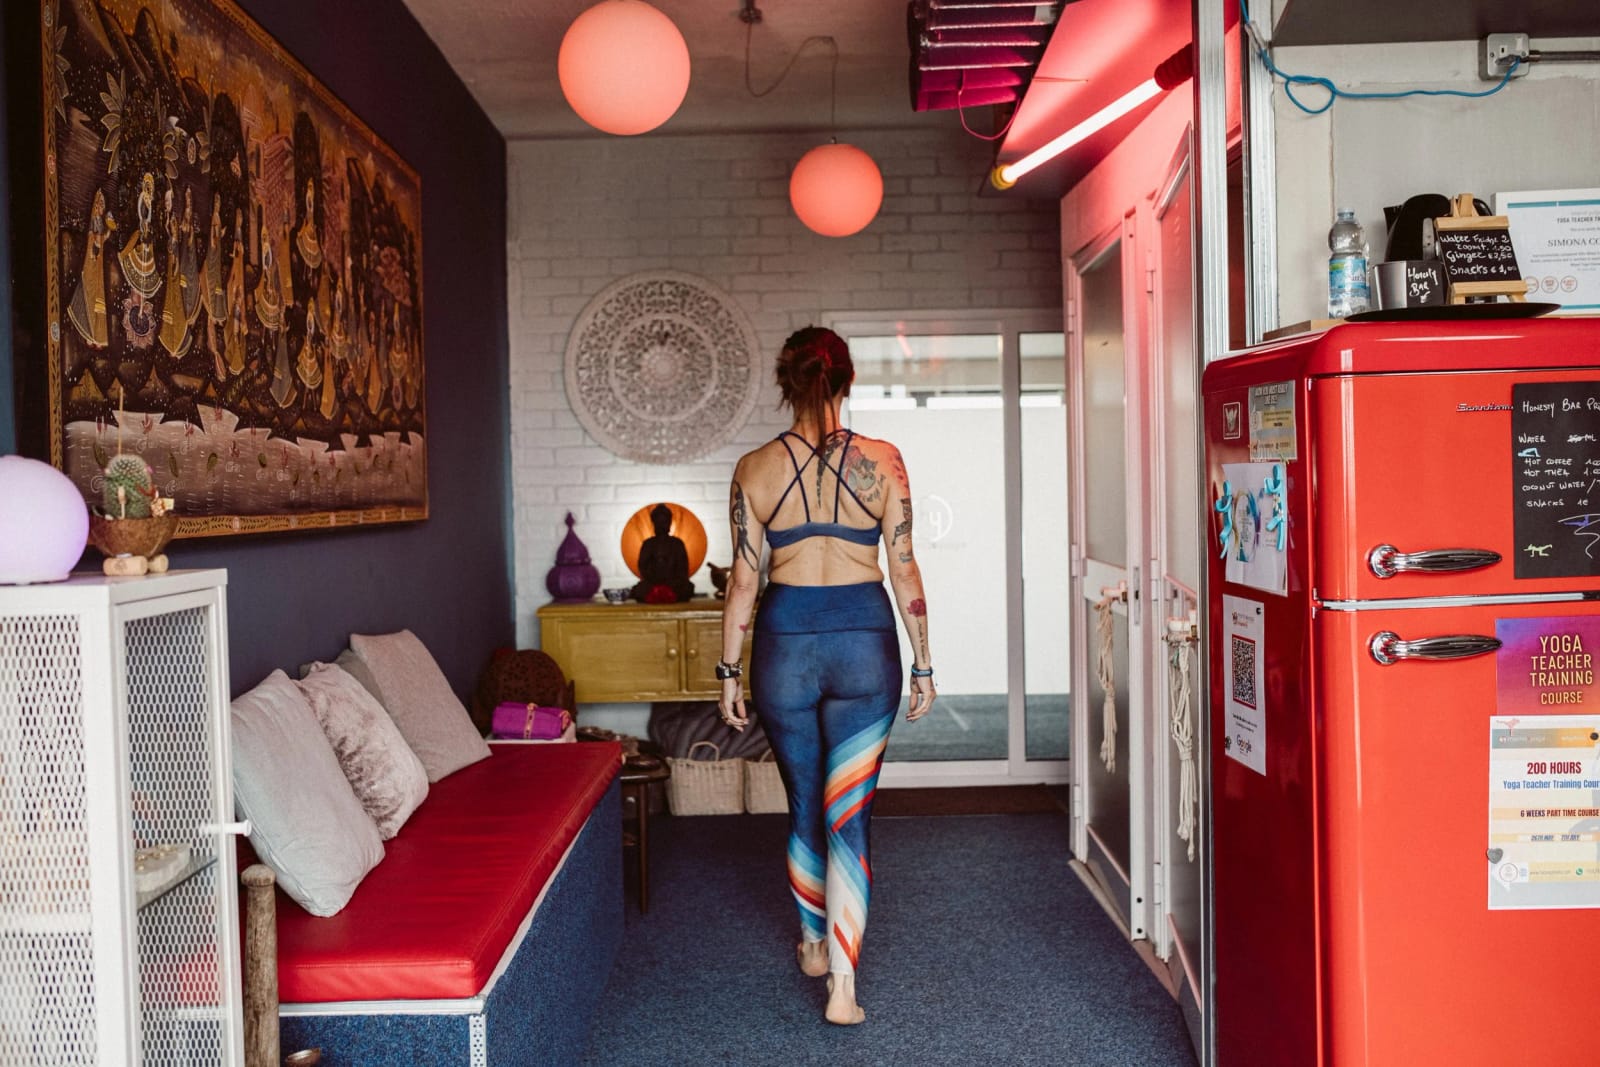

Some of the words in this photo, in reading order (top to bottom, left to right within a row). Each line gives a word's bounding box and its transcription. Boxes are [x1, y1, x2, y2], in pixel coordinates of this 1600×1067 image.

[1547, 238, 1587, 248] SIMONA
[1450, 264, 1489, 275] Snacks
[1524, 458, 1541, 467] HOT
[1523, 468, 1541, 477] HOT
[1540, 634, 1582, 654] YOGA
[1530, 654, 1592, 671] TEACHER
[1529, 670, 1593, 687] TRAINING
[1541, 691, 1583, 705] COURSE
[1527, 762, 1547, 775] 200
[1550, 761, 1582, 775] HOURS
[1503, 780, 1520, 790] Yoga
[1523, 779, 1551, 789] Teacher
[1553, 779, 1581, 790] Training
[1520, 809, 1525, 818] 6
[1526, 809, 1545, 818] WEEKS
[1546, 809, 1561, 817] PART
[1562, 808, 1576, 817] TIME
[1577, 808, 1600, 817] COURSE
